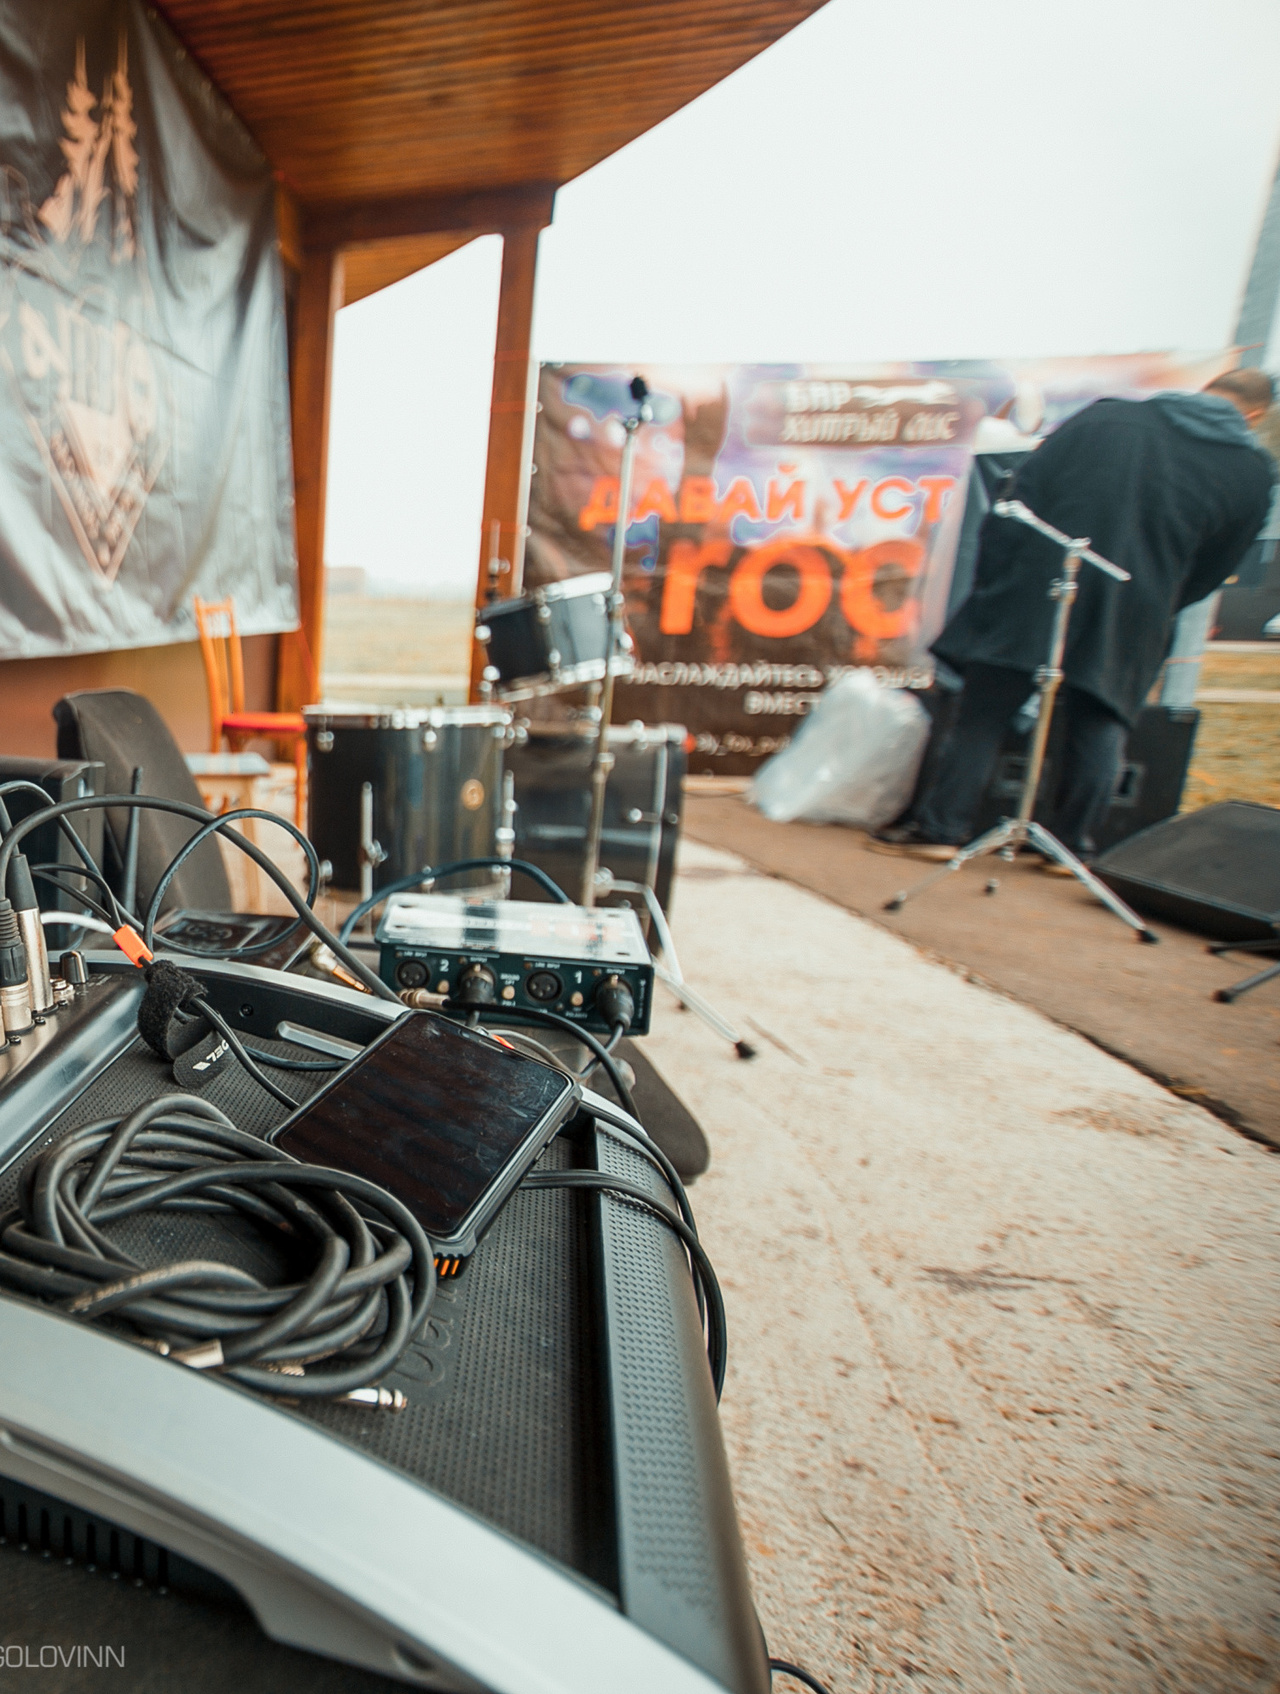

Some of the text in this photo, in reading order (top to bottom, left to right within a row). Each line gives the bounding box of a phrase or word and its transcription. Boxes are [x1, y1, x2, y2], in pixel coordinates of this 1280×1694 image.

[579, 462, 806, 531] ДАВАЙ
[628, 659, 824, 690] НАСЛАЖДАЙТЕСЬ
[439, 959, 449, 972] 2
[574, 971, 582, 984] 1
